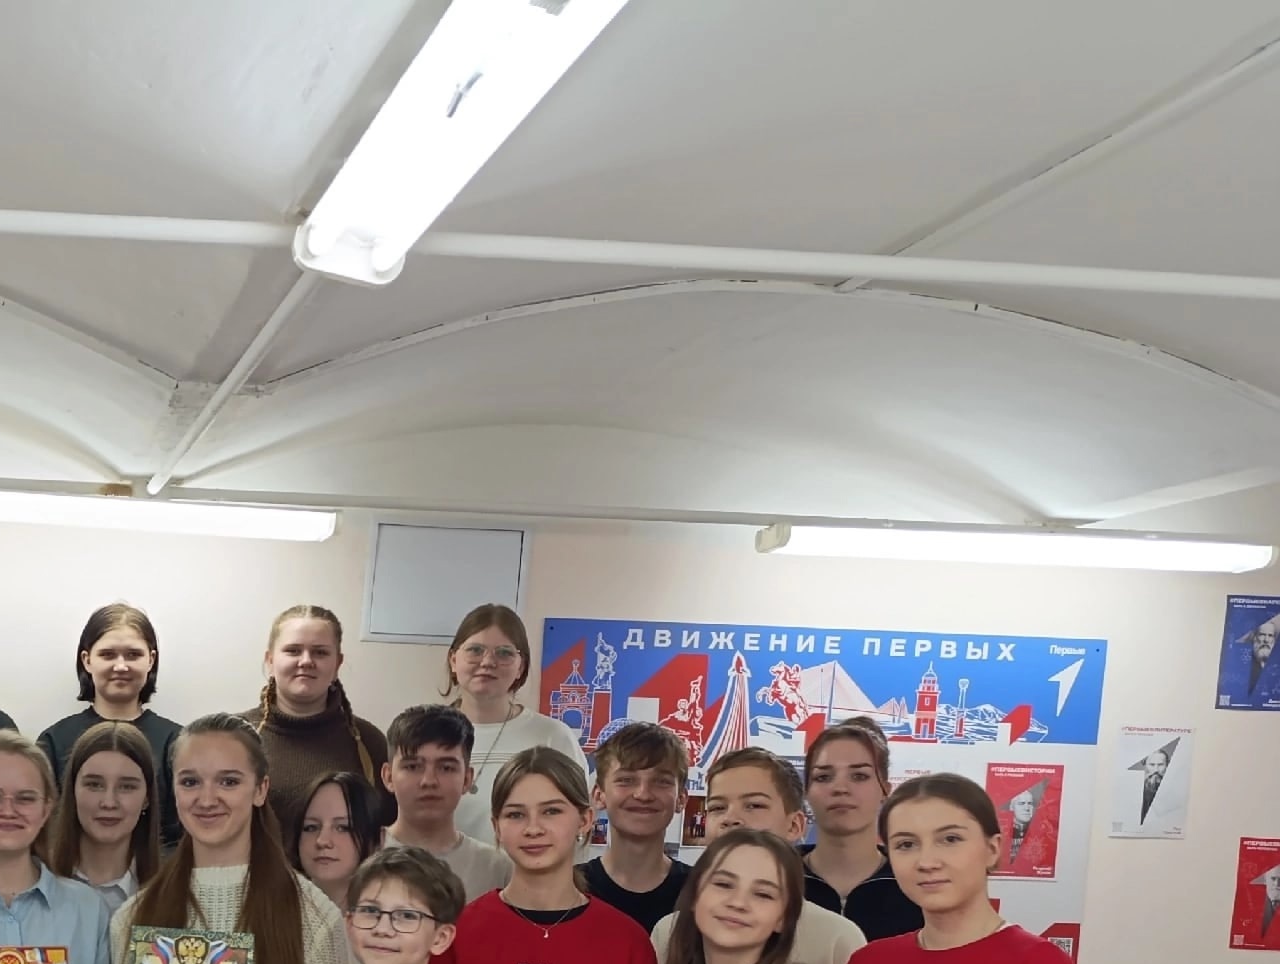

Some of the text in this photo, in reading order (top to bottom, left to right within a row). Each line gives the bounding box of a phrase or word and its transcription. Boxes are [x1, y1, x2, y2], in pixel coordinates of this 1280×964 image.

[623, 628, 1016, 662] ДВИЖЕНИЕ ПЕРВЫХ
[1049, 644, 1086, 656] Первые
